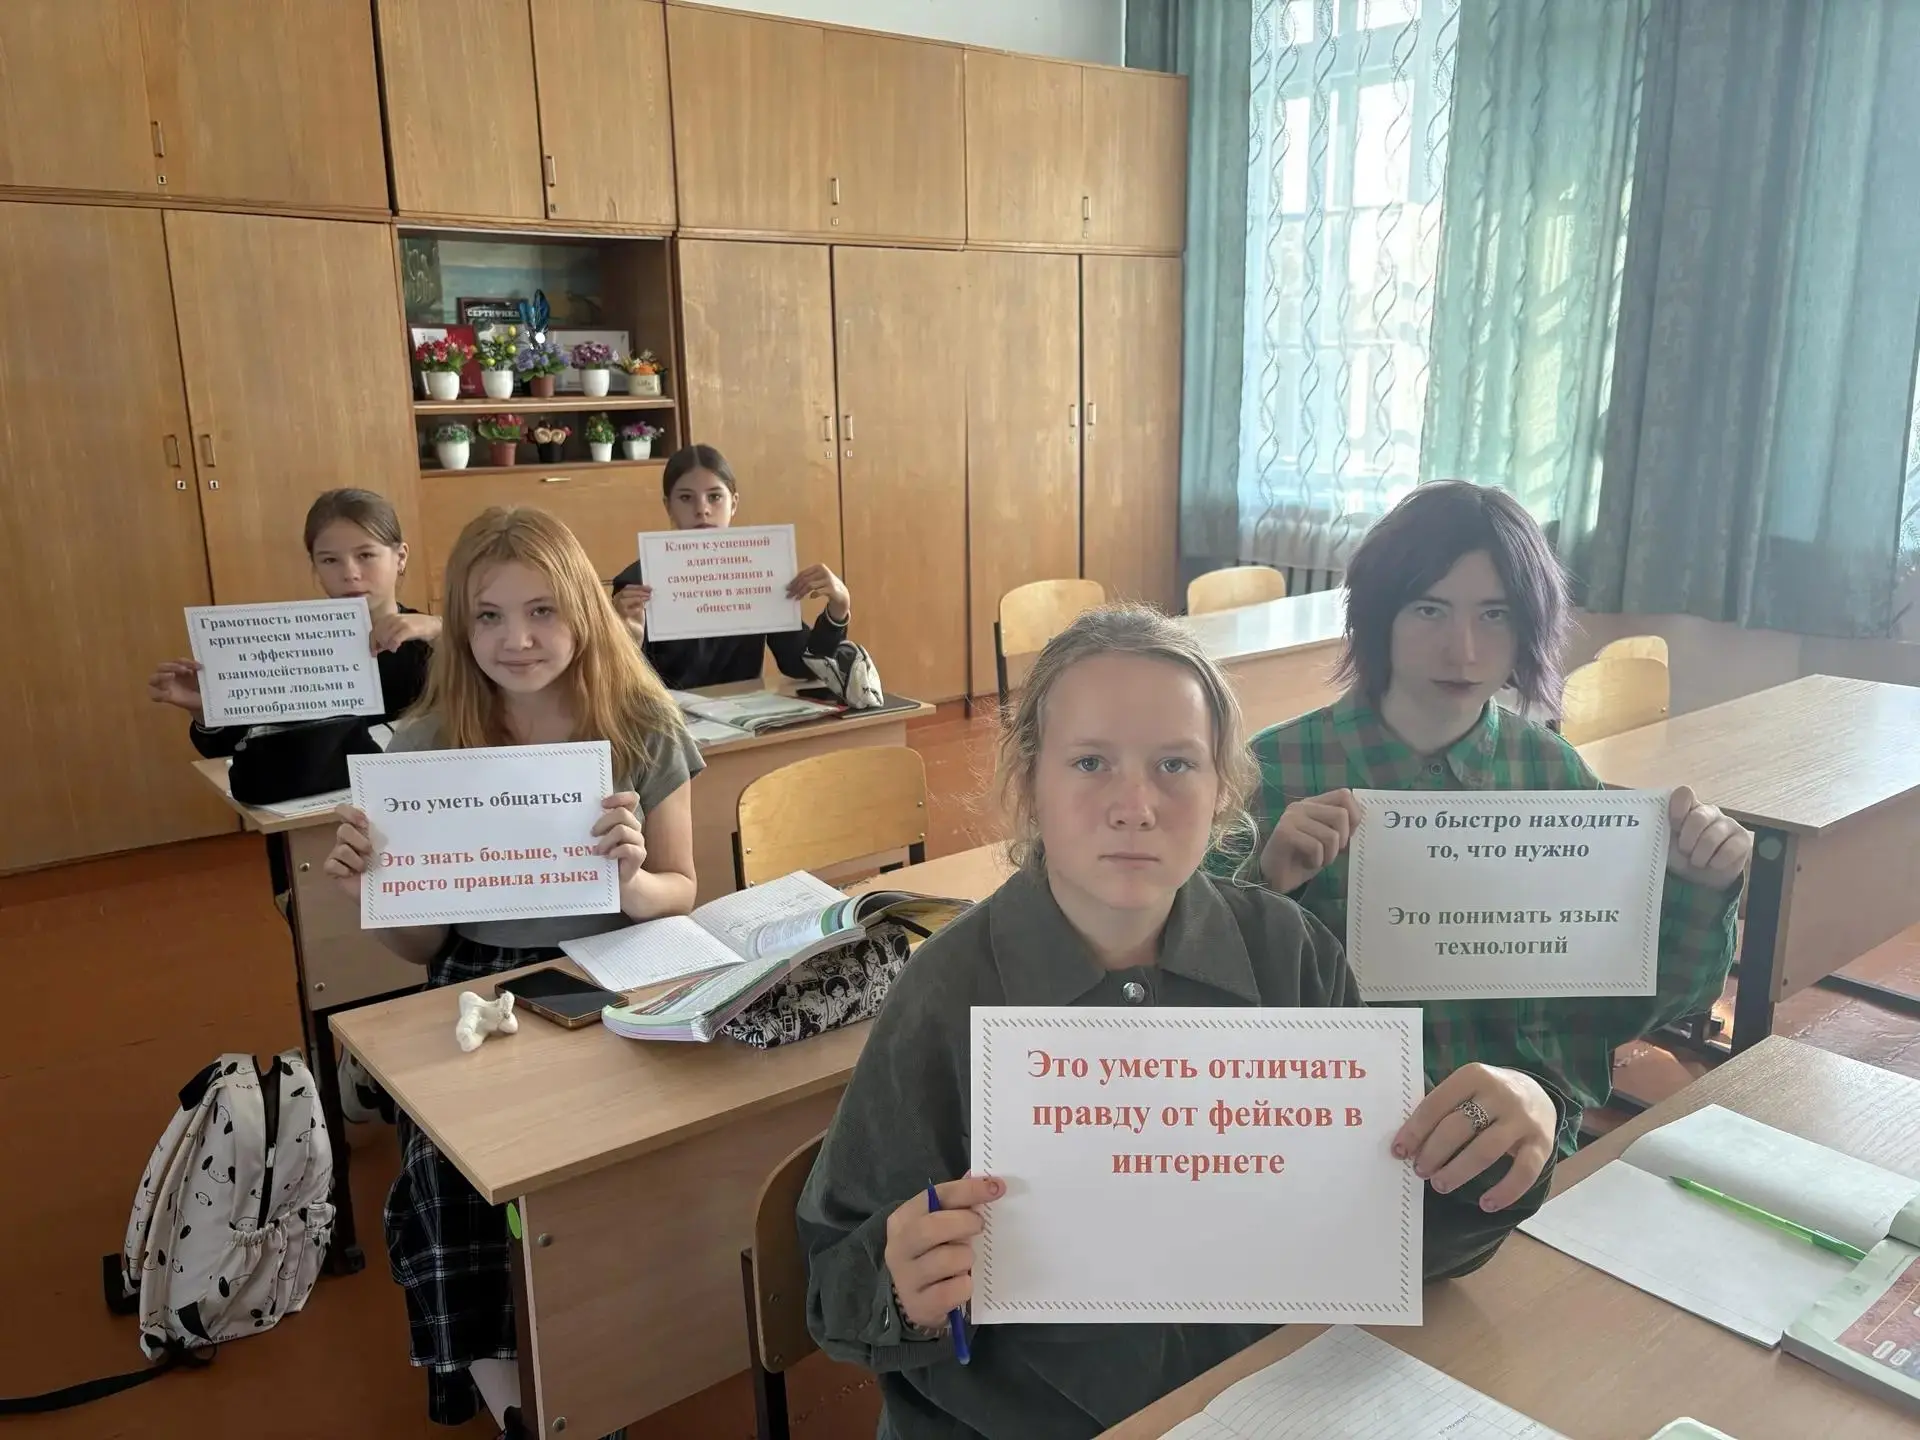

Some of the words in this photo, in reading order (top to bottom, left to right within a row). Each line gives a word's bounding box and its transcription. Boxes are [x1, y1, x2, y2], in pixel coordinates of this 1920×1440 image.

[665, 541, 699, 552] Ключ
[702, 541, 711, 550] к
[766, 569, 774, 577] и
[672, 588, 722, 602] участию
[725, 588, 733, 596] в
[735, 585, 772, 596] жизни
[696, 602, 751, 614] общества
[200, 617, 291, 631] Грамотность
[295, 611, 357, 624] помогает
[208, 632, 291, 648] критически
[295, 627, 356, 640] мыслить
[238, 652, 247, 662] и
[251, 647, 334, 663] эффективно
[217, 664, 349, 681] взаимодействовать
[352, 663, 360, 672] с
[227, 685, 286, 700] другими
[289, 682, 343, 694] людьми
[347, 680, 355, 689] в
[223, 700, 327, 716] многообразном
[330, 697, 365, 710] мире
[384, 796, 421, 813] Это
[427, 794, 484, 814] уметь
[489, 791, 583, 807] общаться
[1384, 811, 1428, 829] Это
[1434, 810, 1522, 833] быстро
[1528, 814, 1640, 830] находить
[379, 851, 415, 868] Это
[420, 849, 474, 866] знать
[480, 847, 558, 863] больше,
[1427, 844, 1459, 861] то,
[1467, 844, 1507, 858] что
[1514, 844, 1590, 862] нужно
[382, 878, 448, 896] просто
[454, 873, 534, 893] правила
[540, 870, 599, 884] языка
[1388, 907, 1431, 925] Это
[1438, 909, 1552, 925] понимать
[1559, 908, 1620, 923] язык
[1435, 936, 1569, 956] технологий
[1027, 1049, 1089, 1079] Это
[1099, 1057, 1198, 1086] уметь
[1208, 1057, 1367, 1080] отличать
[1032, 1105, 1151, 1134] правду
[1161, 1106, 1199, 1127] от
[1208, 1099, 1334, 1135] фейков
[1344, 1106, 1363, 1127] в
[1111, 1153, 1285, 1182] интернете
